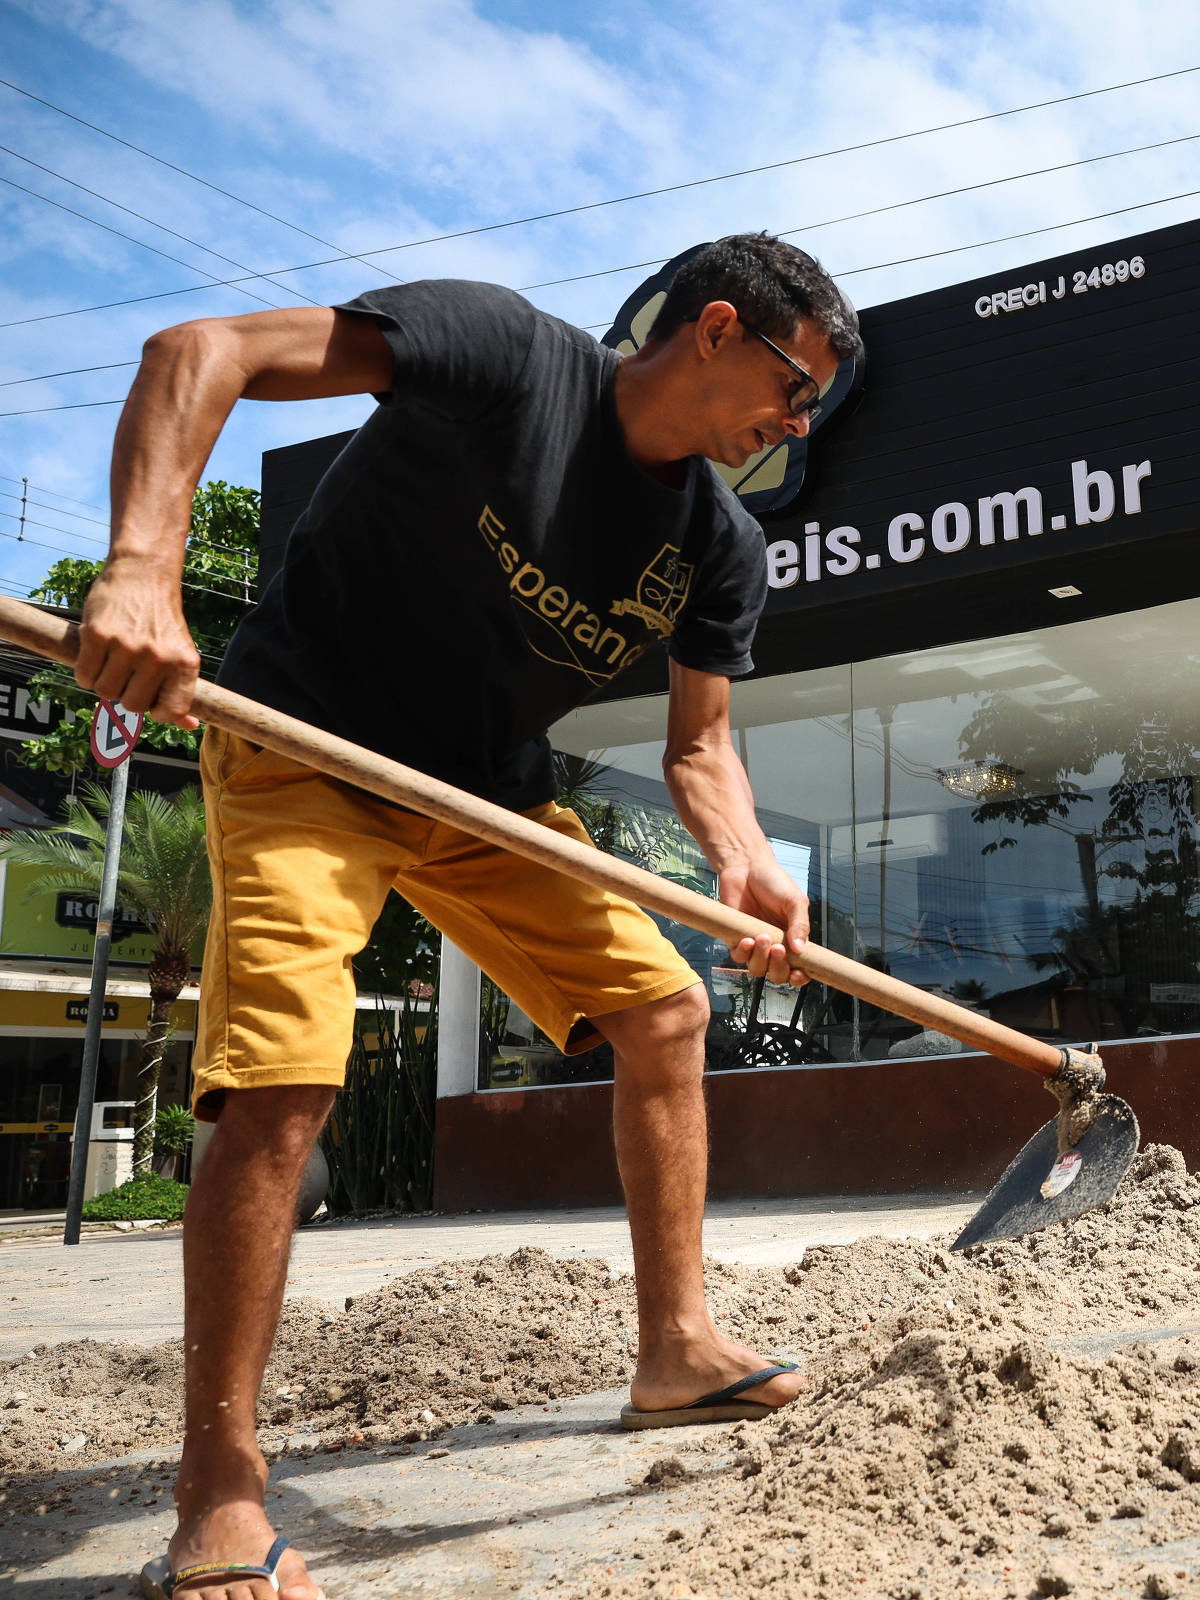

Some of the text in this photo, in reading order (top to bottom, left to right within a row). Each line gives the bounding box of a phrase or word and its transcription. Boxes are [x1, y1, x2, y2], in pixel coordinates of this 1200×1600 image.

[975, 255, 1146, 318] CRECI J 24896
[766, 459, 1152, 590] eis.com.br
